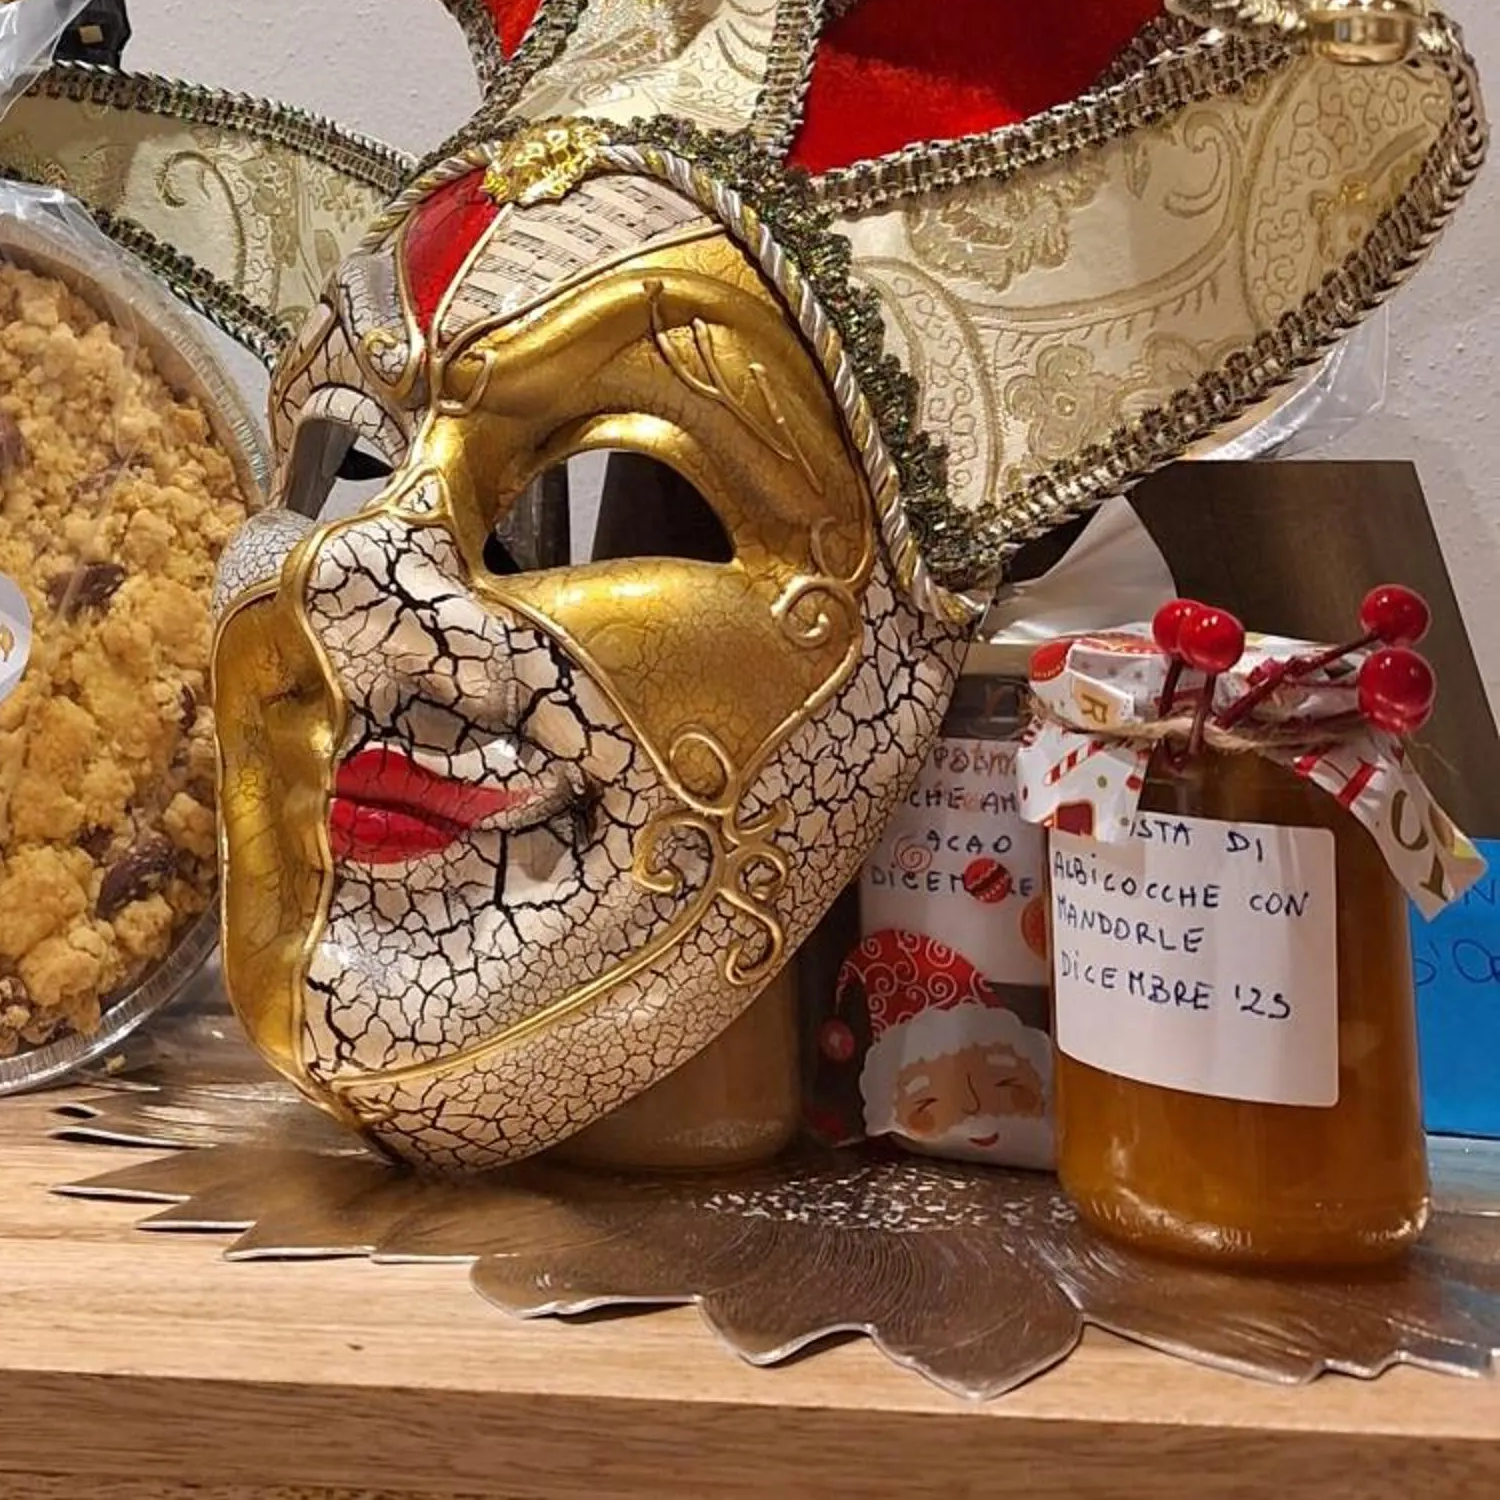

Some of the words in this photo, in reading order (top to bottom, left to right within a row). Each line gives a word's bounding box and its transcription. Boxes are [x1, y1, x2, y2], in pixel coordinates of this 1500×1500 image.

[904, 787, 964, 810] CHE
[1130, 819, 1191, 846] STA
[1249, 891, 1309, 917] CON
[1057, 894, 1205, 952] MANDORLE
